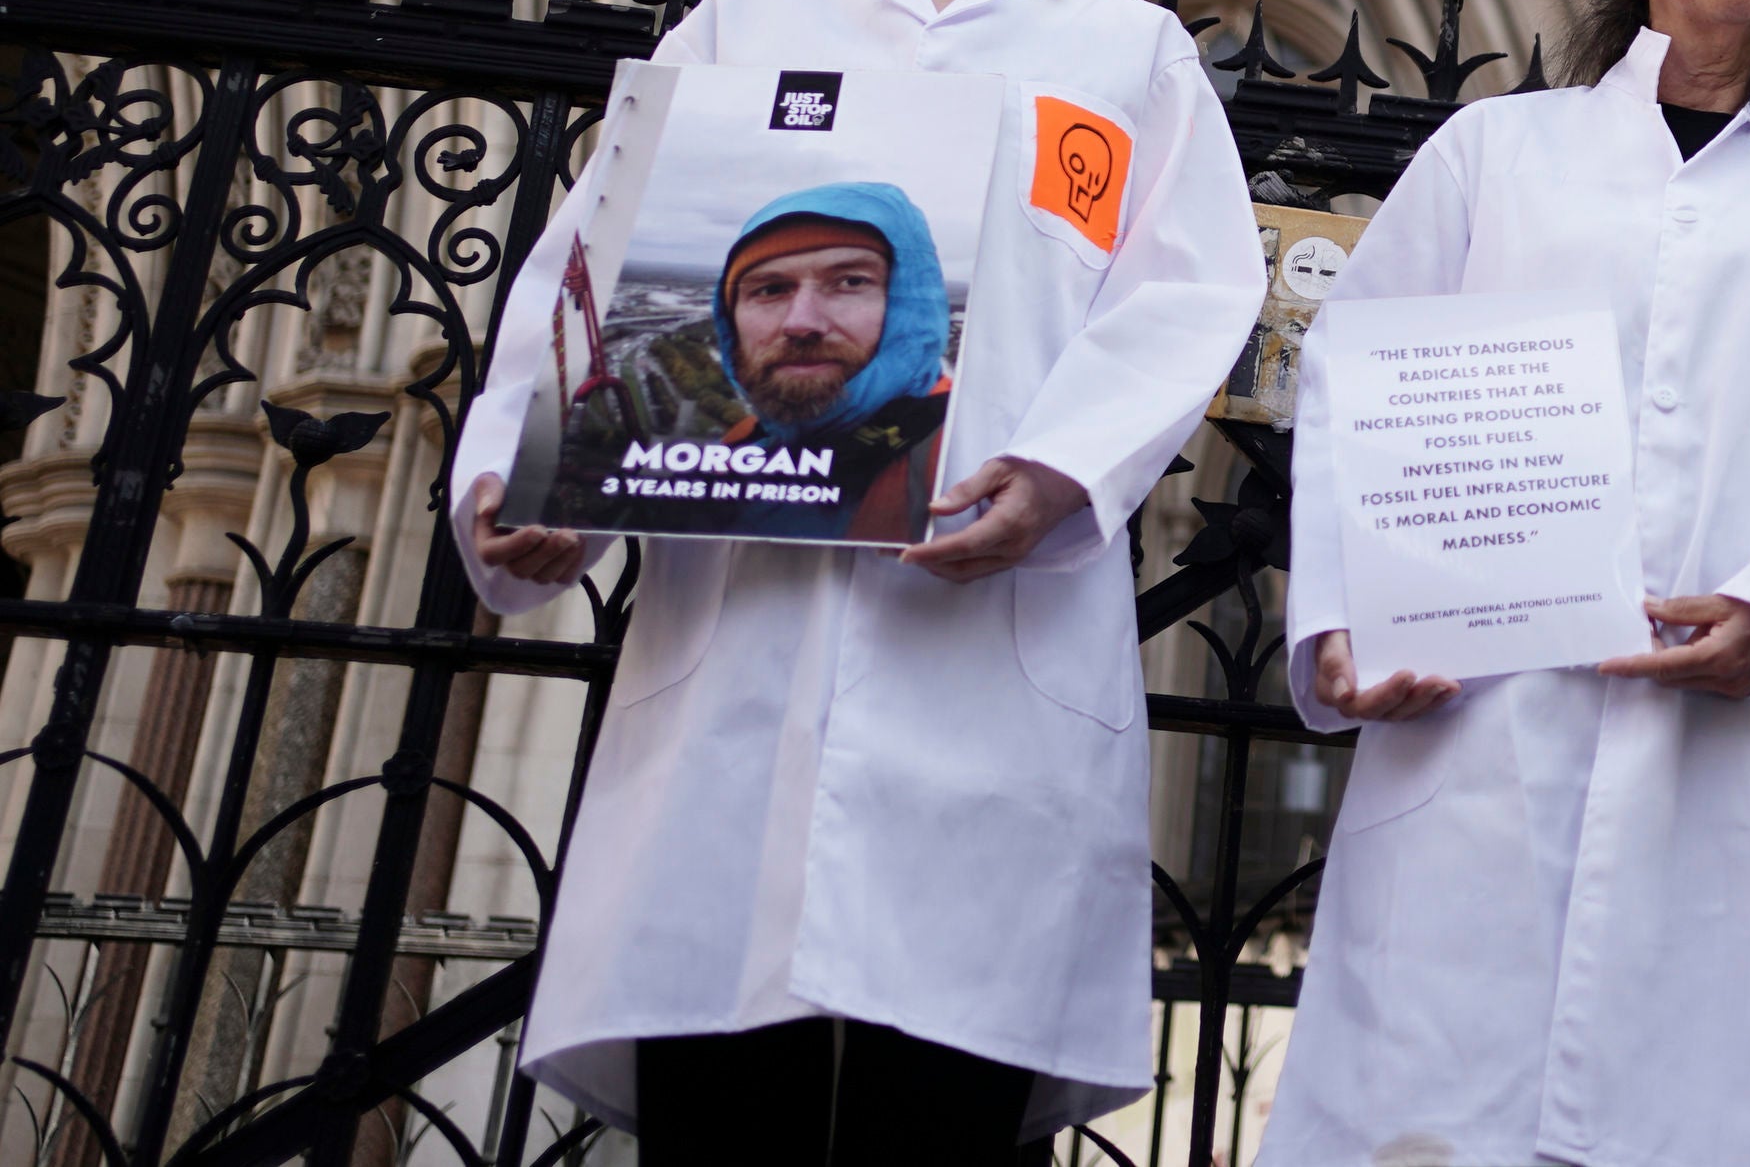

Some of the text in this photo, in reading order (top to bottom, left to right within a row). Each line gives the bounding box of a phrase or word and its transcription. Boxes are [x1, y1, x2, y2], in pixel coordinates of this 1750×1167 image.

[779, 92, 824, 106] JUST
[788, 103, 833, 115] STOP
[784, 114, 813, 125] OIL
[1413, 345, 1462, 359] TRULY
[1469, 339, 1574, 355] DANGEROUS
[1399, 362, 1550, 382] RADICALS ARE THE
[1388, 383, 1565, 405] COUNTRIES THAT ARE
[1354, 402, 1603, 431] INCREASING PRODUCTION OF
[1425, 430, 1537, 449] FOSSIL FUELS.
[621, 440, 833, 477] MORGAN
[1403, 454, 1564, 477] INVESTING IN NEW
[601, 477, 841, 503] 3 YEARS IN PRISON
[1361, 474, 1611, 506] FOSSIL FUEL INFRASTRUCTURE
[1376, 498, 1602, 529] IS MORAL AND ECONOMIC
[1392, 593, 1603, 624] UN SECRETARY-GENERAL ANTONIO GUTERRES
[1467, 618, 1495, 629] APRIL
[1508, 614, 1530, 624] 2022
